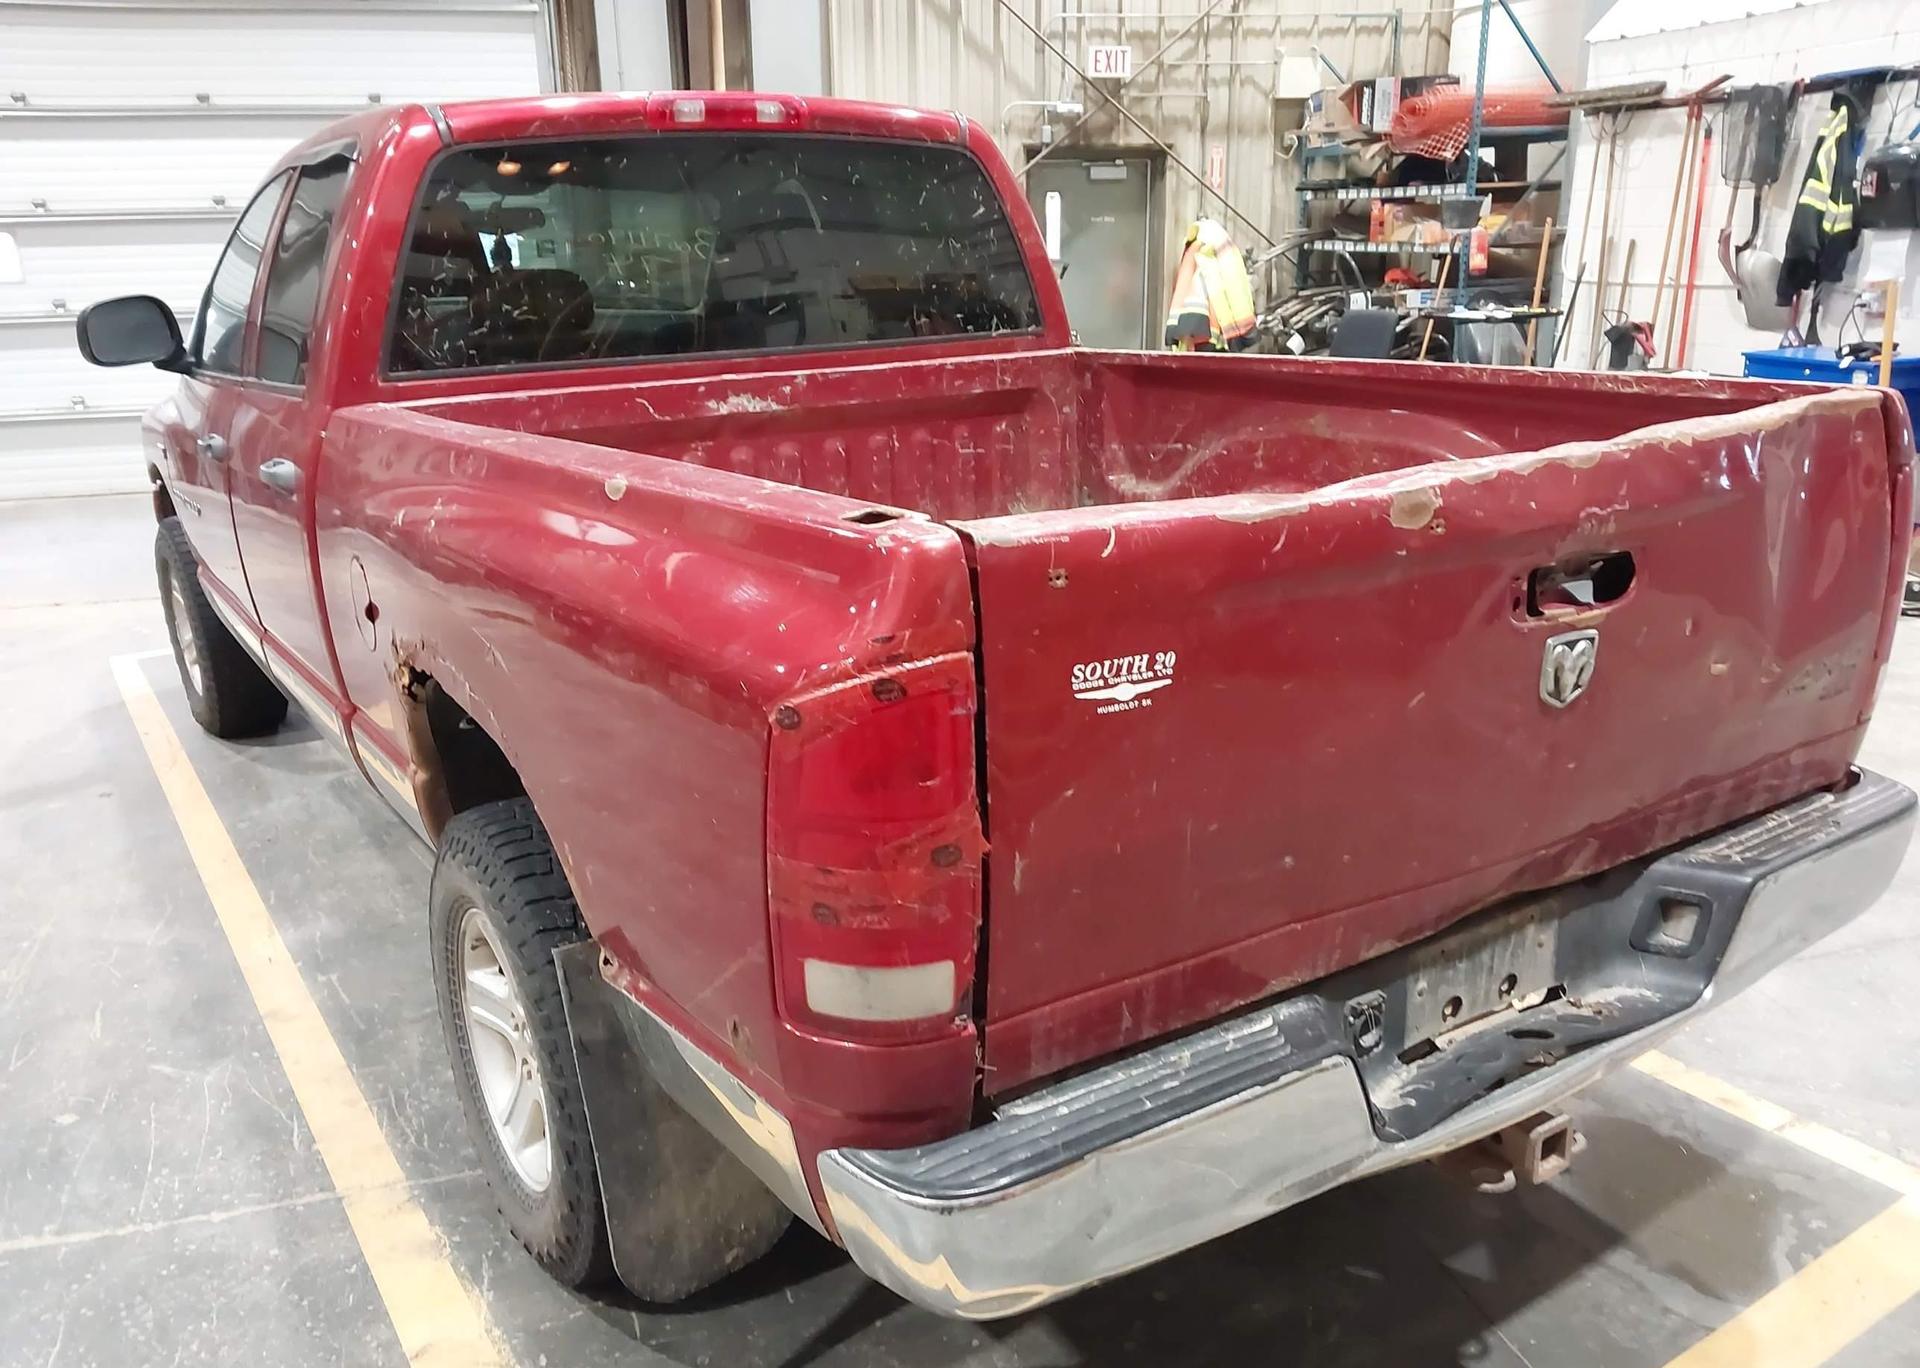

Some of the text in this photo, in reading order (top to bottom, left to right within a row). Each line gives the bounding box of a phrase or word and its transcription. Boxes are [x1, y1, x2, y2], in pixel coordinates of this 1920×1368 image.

[1094, 49, 1127, 73] EXIT
[1072, 651, 1176, 683] SOUTH 20
[1097, 701, 1139, 715] HUMBOLDT
